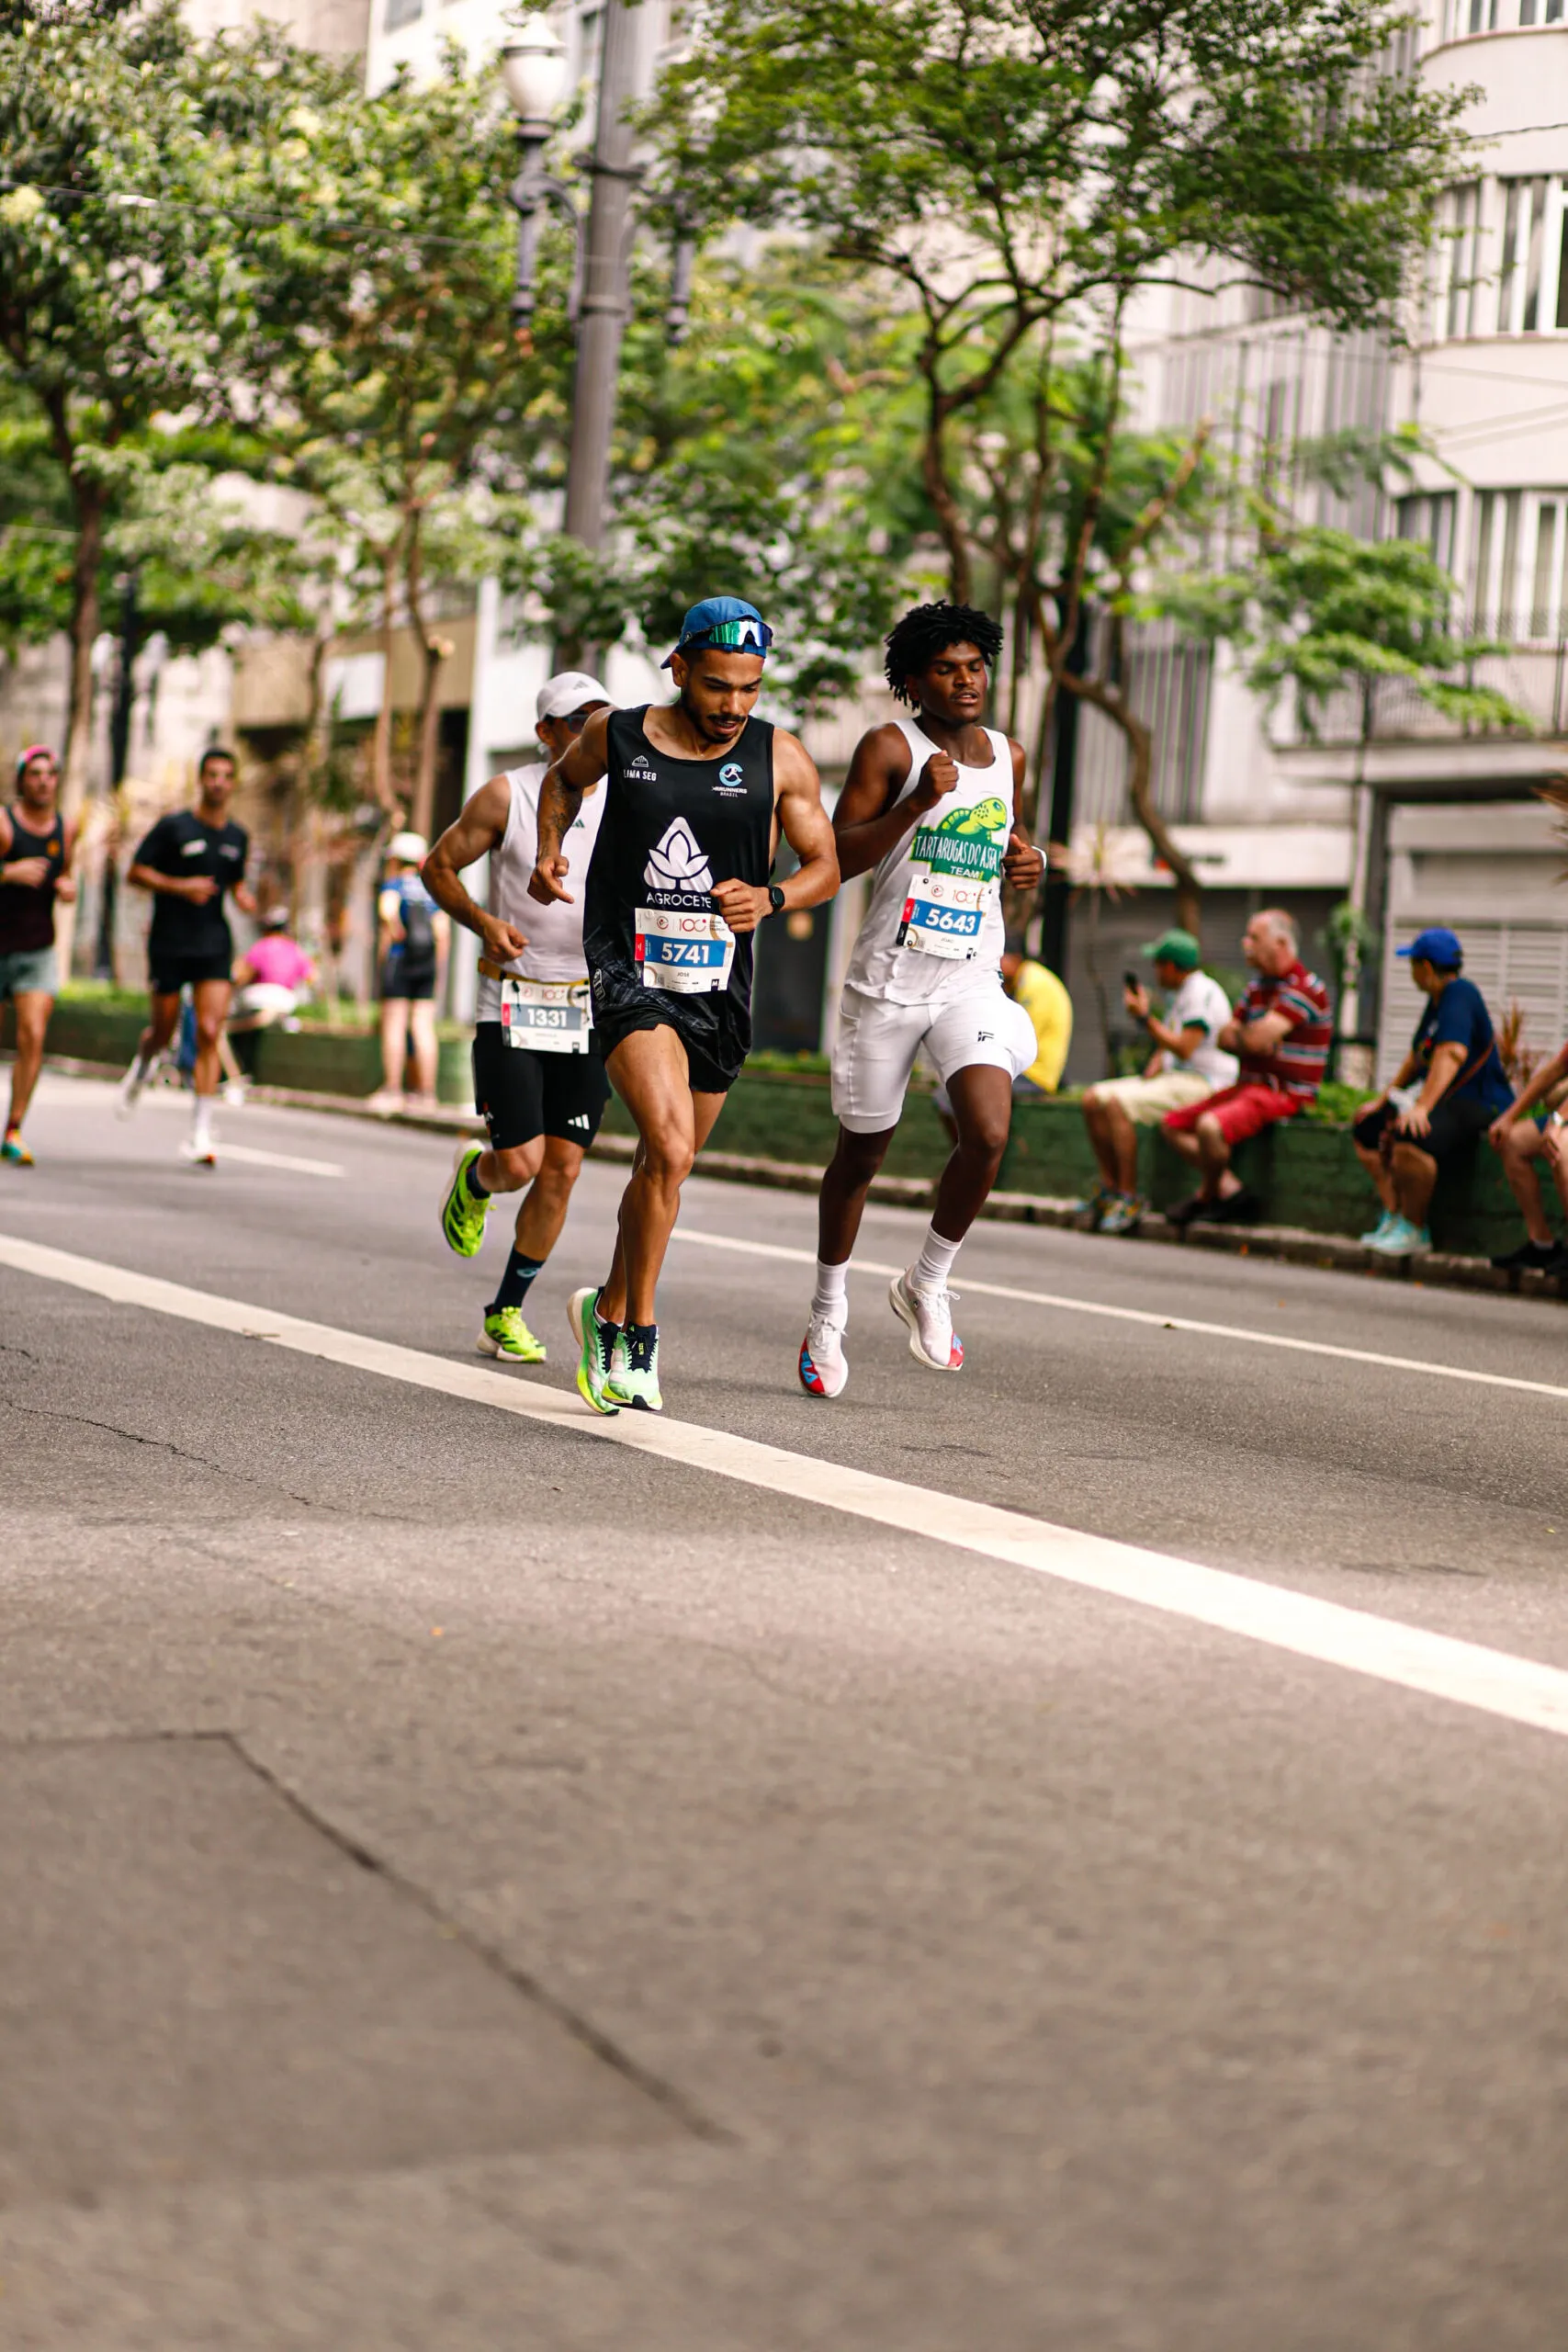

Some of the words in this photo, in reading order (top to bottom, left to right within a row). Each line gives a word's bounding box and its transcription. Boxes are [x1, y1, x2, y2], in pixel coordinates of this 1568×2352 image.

[623, 769, 640, 779] LIMA
[642, 770, 658, 782] SEG
[915, 836, 968, 864] TARTARUGAS
[646, 892, 712, 909] AGROCETE
[925, 908, 976, 933] 5643
[661, 943, 710, 965] 5741
[527, 1008, 568, 1028] 1331
